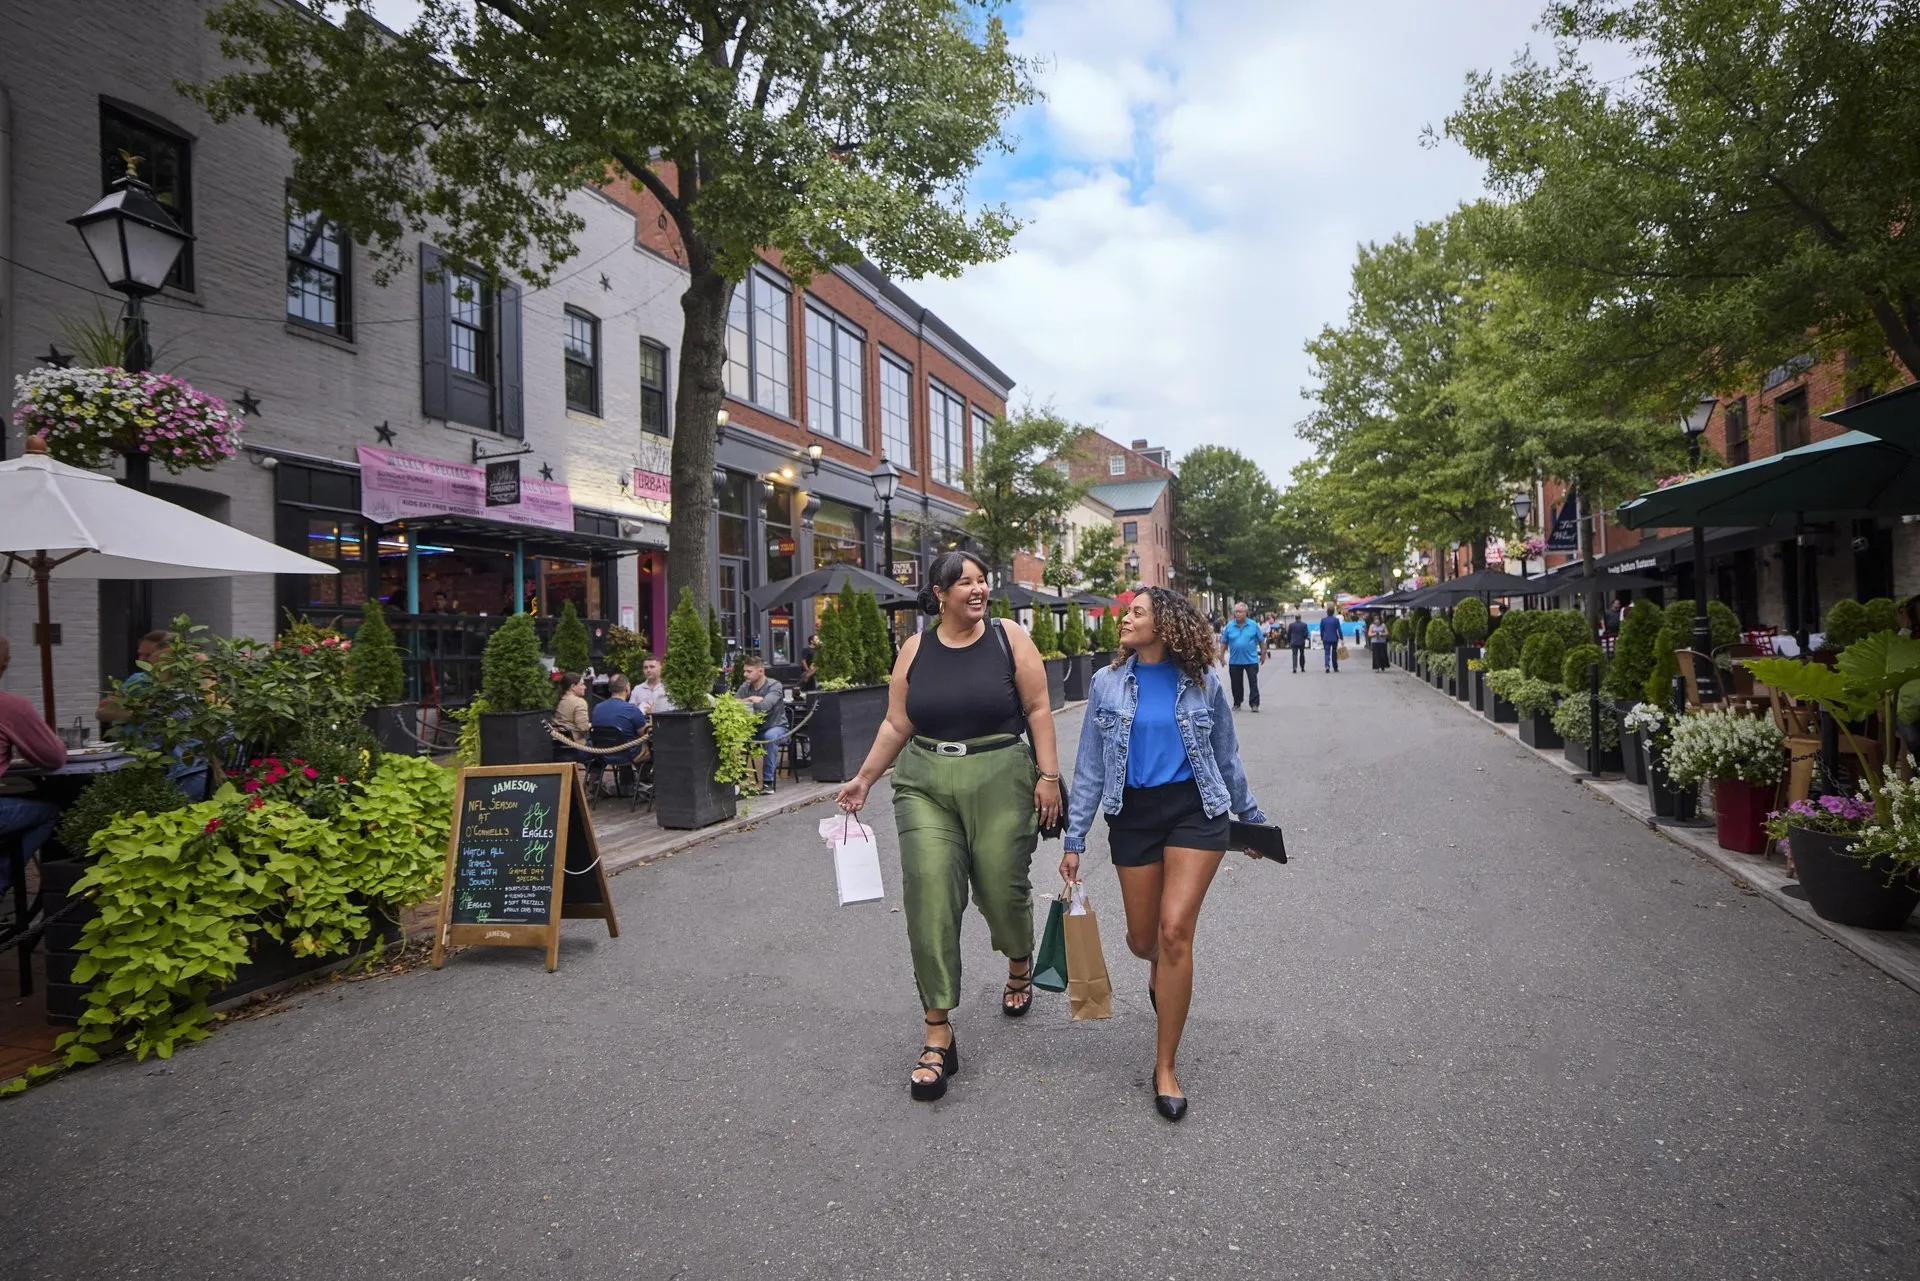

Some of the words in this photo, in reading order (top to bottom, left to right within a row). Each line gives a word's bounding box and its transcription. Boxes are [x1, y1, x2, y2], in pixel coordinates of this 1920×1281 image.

[638, 473, 671, 494] URBAN
[402, 499, 418, 508] KIDS
[419, 500, 431, 509] EAT
[432, 502, 447, 511] FREE
[448, 504, 484, 515] WEDNESDAY
[491, 780, 537, 795] JAMESON
[468, 800, 486, 812] NFL
[489, 798, 519, 811] SEASON
[478, 812, 490, 824] AT
[522, 828, 554, 838] EAGLES
[463, 847, 486, 858] WATCH
[490, 847, 504, 858] ALL
[468, 859, 492, 868] GAMES
[461, 869, 476, 877] LIVE
[480, 868, 498, 876] WITH
[508, 867, 527, 876] GAME
[467, 901, 492, 909] EAGLES
[484, 930, 511, 939] JAMESON
